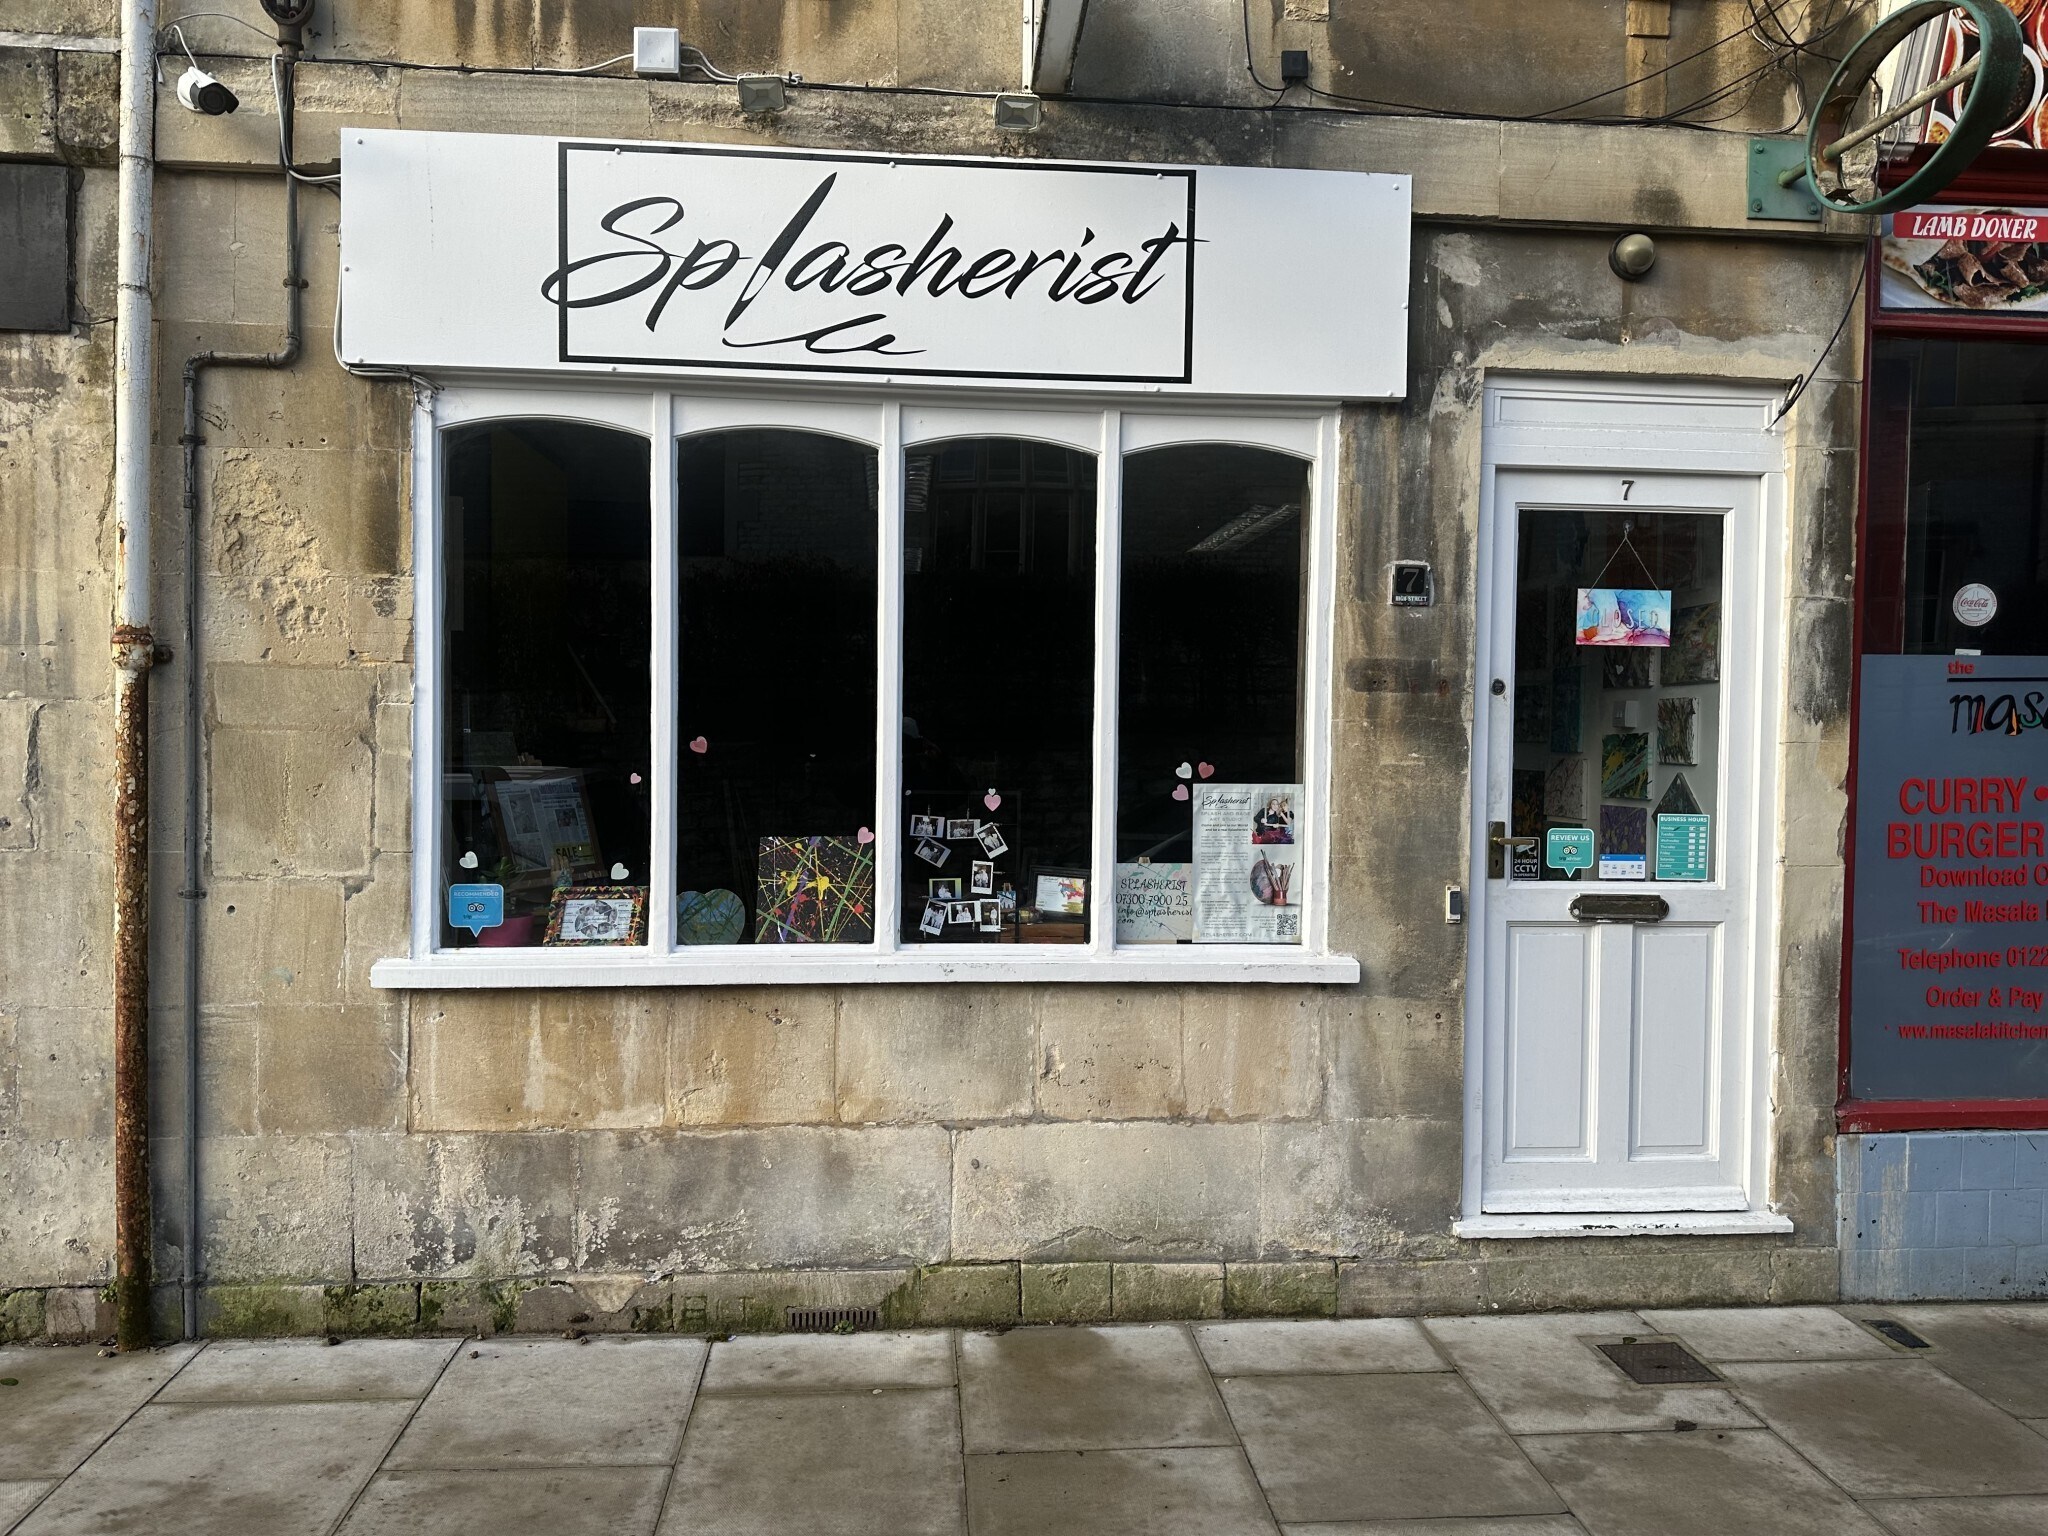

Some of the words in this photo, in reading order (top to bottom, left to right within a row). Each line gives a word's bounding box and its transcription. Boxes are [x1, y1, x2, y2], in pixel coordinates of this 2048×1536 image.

[1912, 215, 1966, 238] LAMB
[1970, 217, 2038, 240] DONER
[541, 172, 1210, 354] Splasherist
[1621, 479, 1635, 501] 7
[1402, 568, 1420, 593] 7
[1591, 608, 1659, 630] CLOSED
[1947, 658, 1975, 675] the
[1949, 691, 2048, 737] mas
[1899, 776, 2028, 815] CURRY
[555, 846, 579, 858] SALE
[1887, 821, 2044, 859] BURGER
[1514, 864, 1538, 873] CCTV
[1920, 864, 2028, 888] Download
[1120, 878, 1188, 891] SPLASHERIST
[1115, 893, 1145, 904] 07300
[1148, 894, 1173, 906] 7900
[1175, 895, 1188, 906] 25
[1917, 900, 1958, 924] The
[1964, 900, 2040, 924] Masala
[1898, 947, 2001, 974] Telephone
[1926, 985, 1983, 1009] Order
[1988, 986, 2002, 1008] &
[2008, 986, 2044, 1013] Pay
